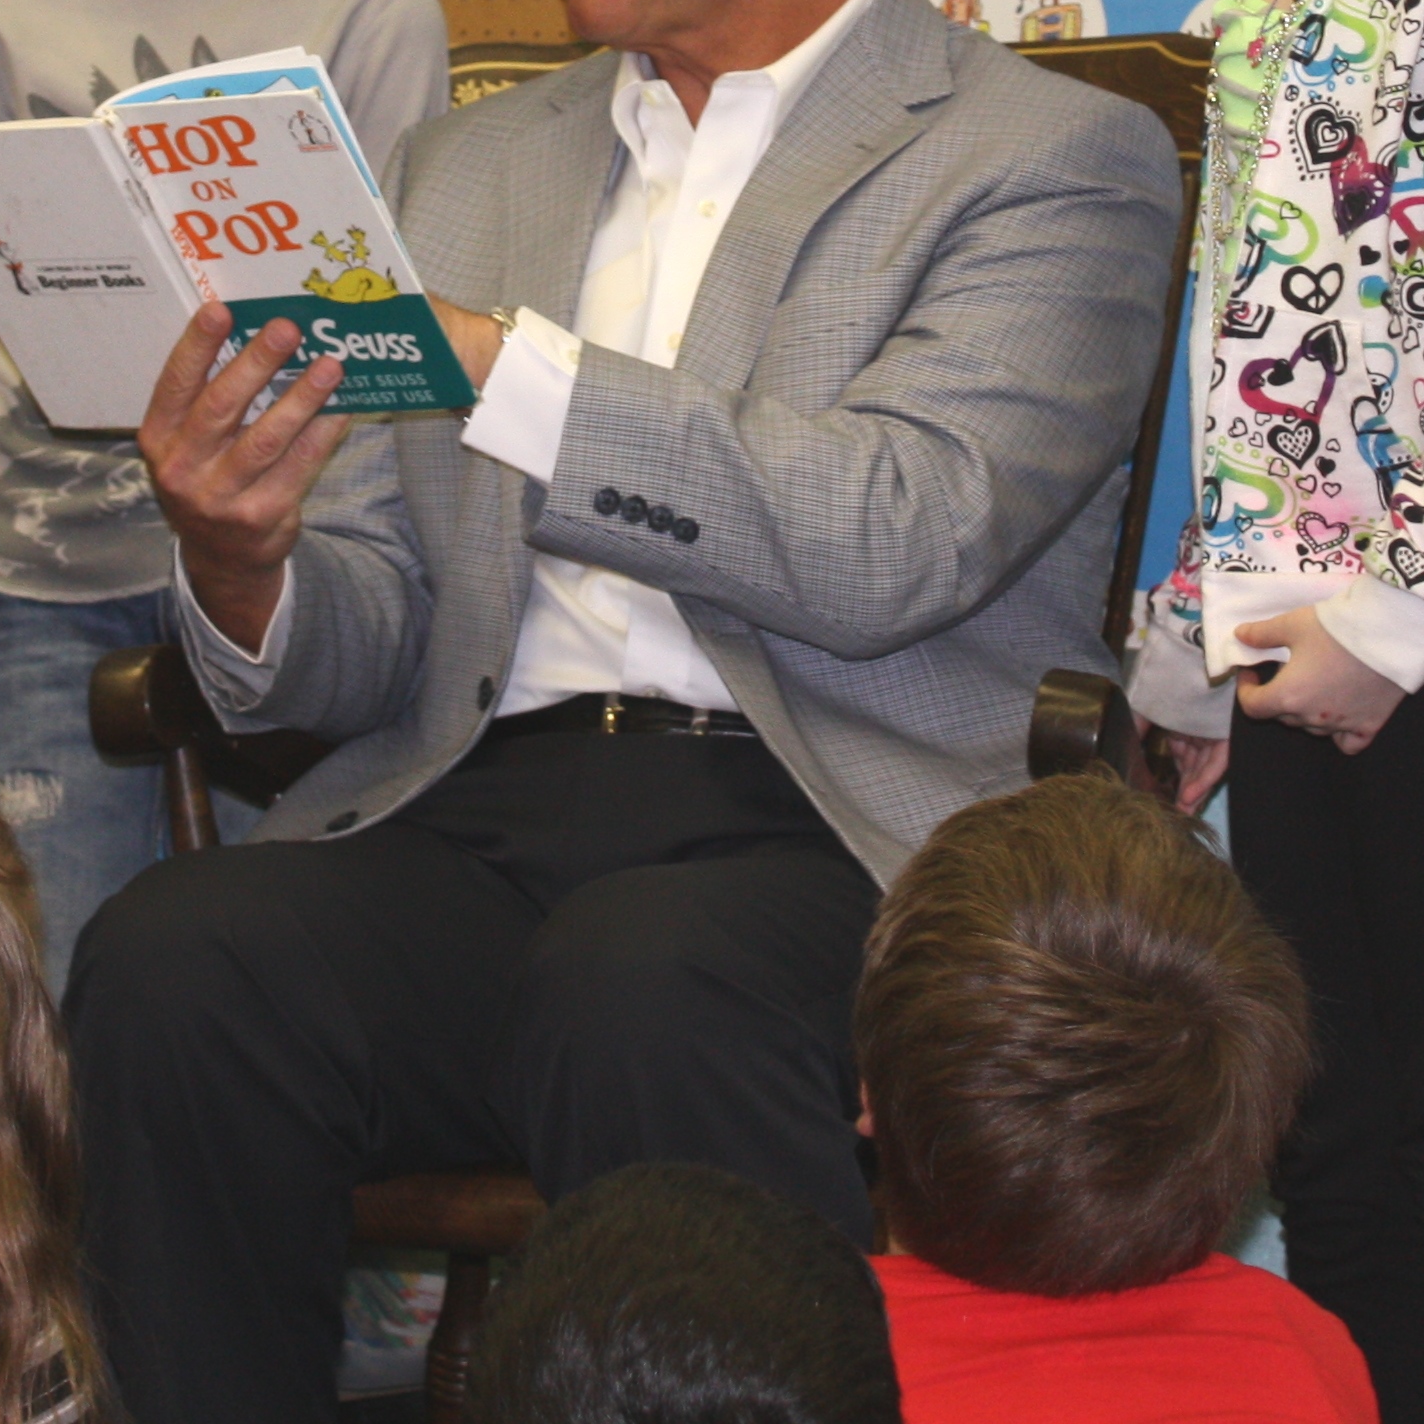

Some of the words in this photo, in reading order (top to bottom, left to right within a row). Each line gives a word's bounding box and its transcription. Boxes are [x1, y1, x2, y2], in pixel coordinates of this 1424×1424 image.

[124, 114, 259, 176] HOP
[189, 177, 239, 203] ON
[174, 199, 305, 262] POP
[99, 274, 146, 288] Books
[311, 317, 424, 363] Seuss
[377, 372, 428, 388] SEUSS
[402, 389, 436, 404] USE
